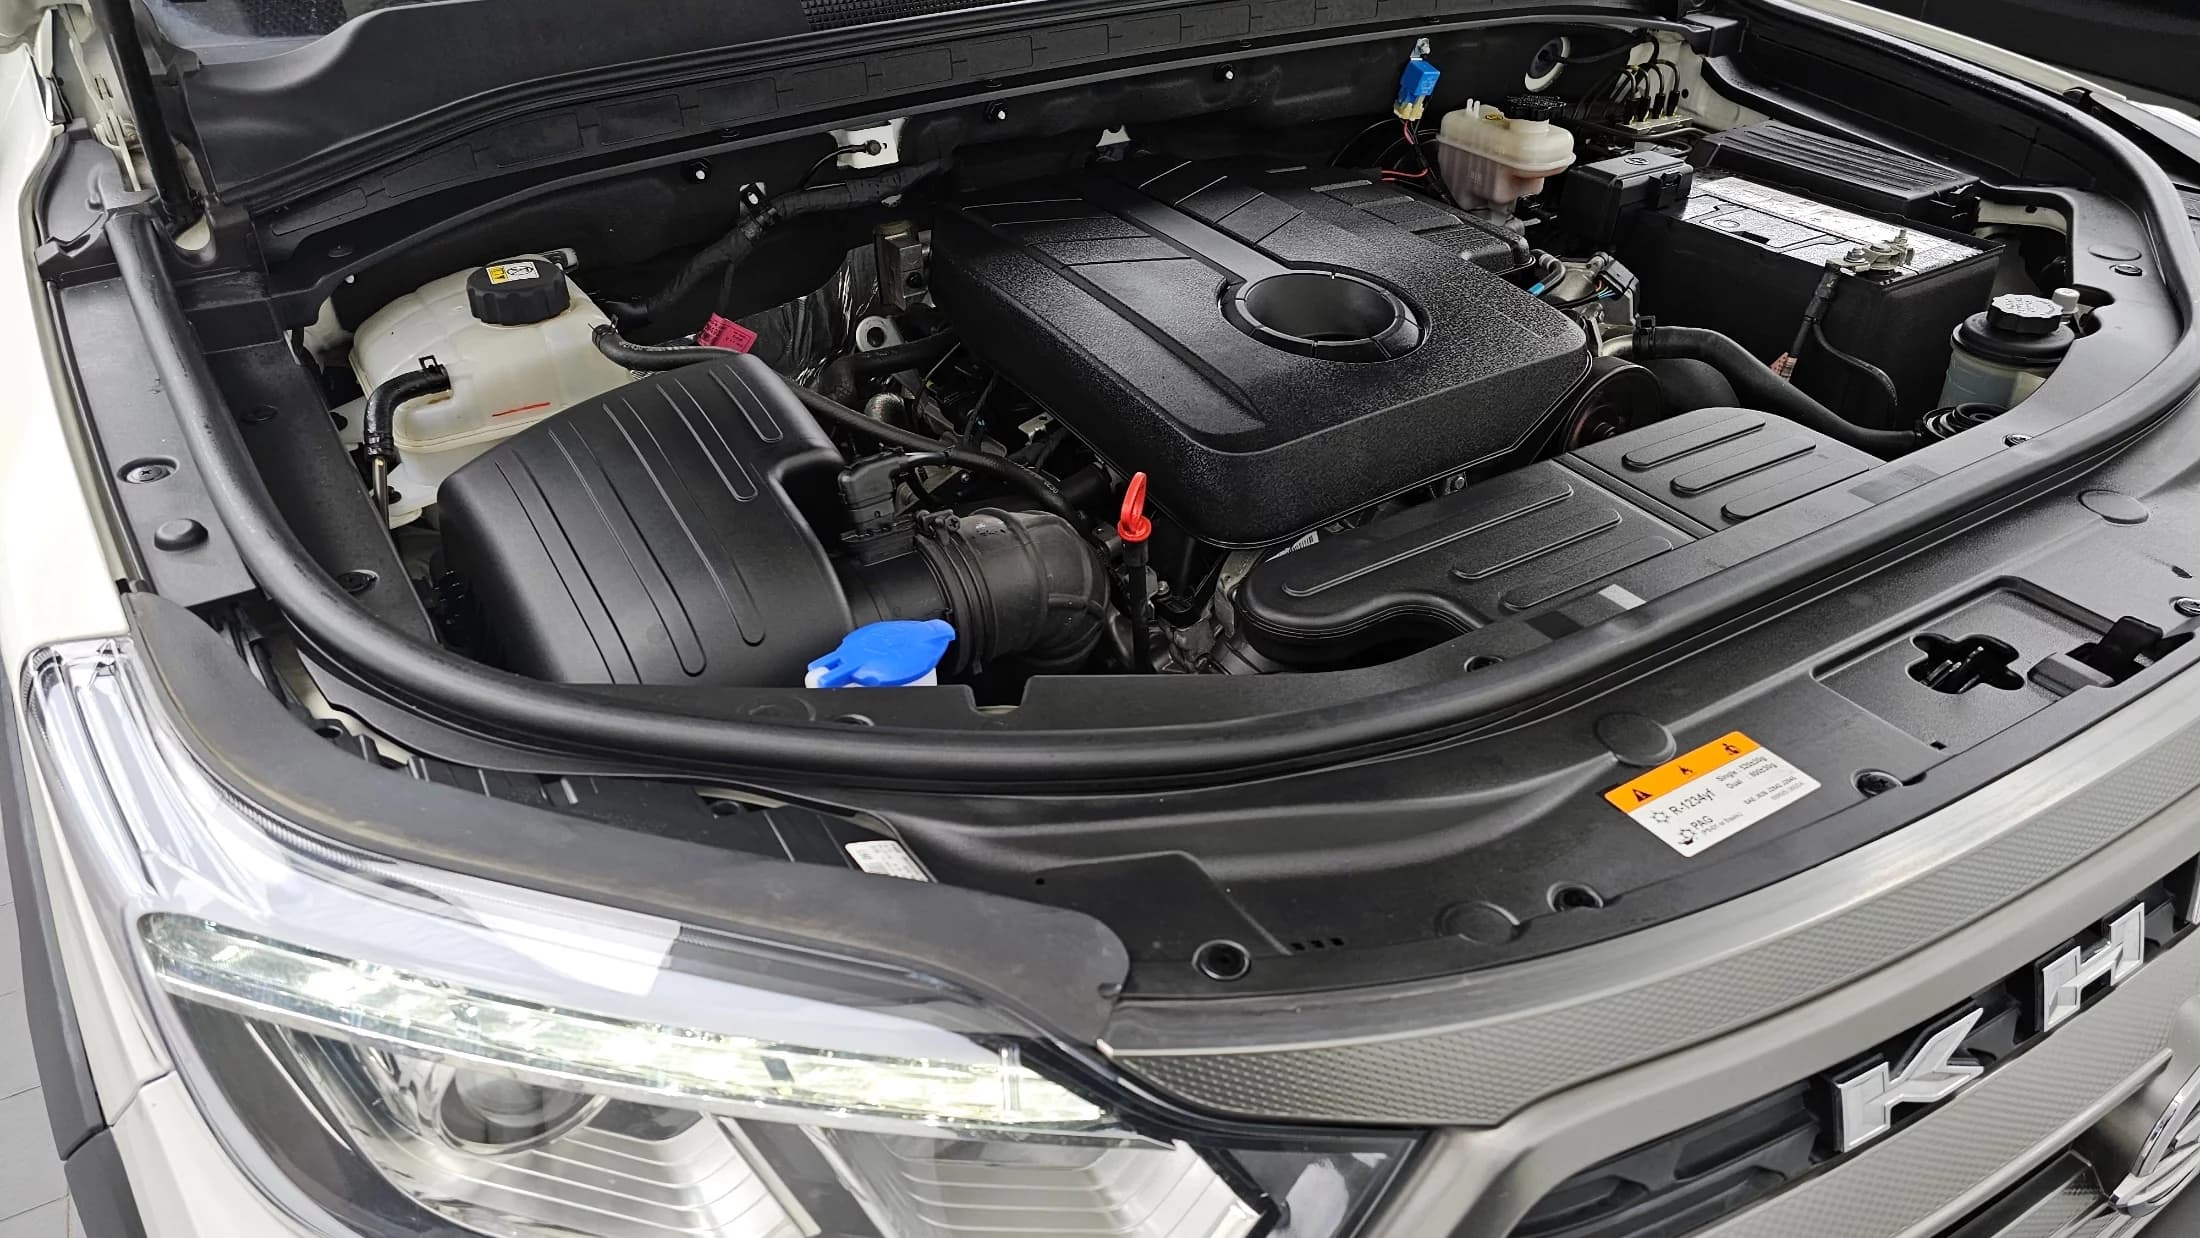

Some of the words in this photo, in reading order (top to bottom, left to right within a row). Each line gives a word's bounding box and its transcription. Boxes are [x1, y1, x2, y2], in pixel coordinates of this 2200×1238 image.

[1668, 787, 1716, 816] R-1234yf
[1690, 815, 1714, 830] PAG
[1836, 866, 2200, 1153] KH
